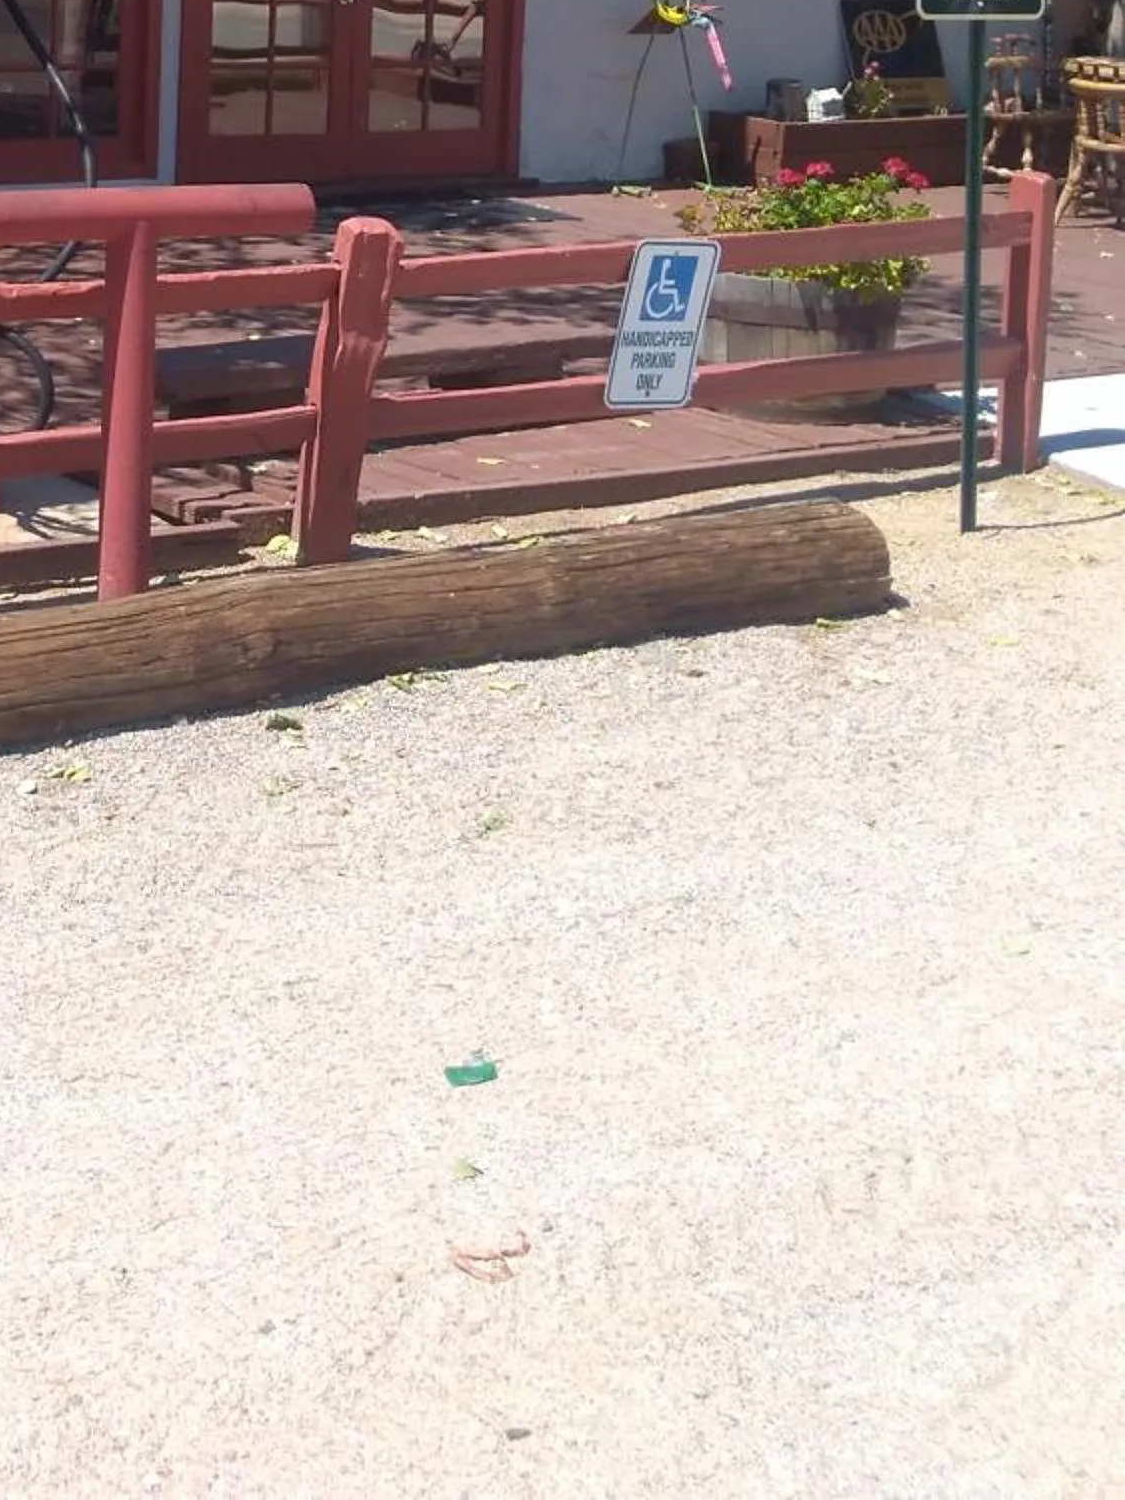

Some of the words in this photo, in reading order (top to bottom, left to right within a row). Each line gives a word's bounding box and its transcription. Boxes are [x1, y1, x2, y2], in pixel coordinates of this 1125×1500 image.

[857, 13, 901, 50] AAA
[620, 331, 694, 348] HANDICAPPED
[630, 351, 676, 370] PARKING
[636, 373, 664, 391] ONLY
